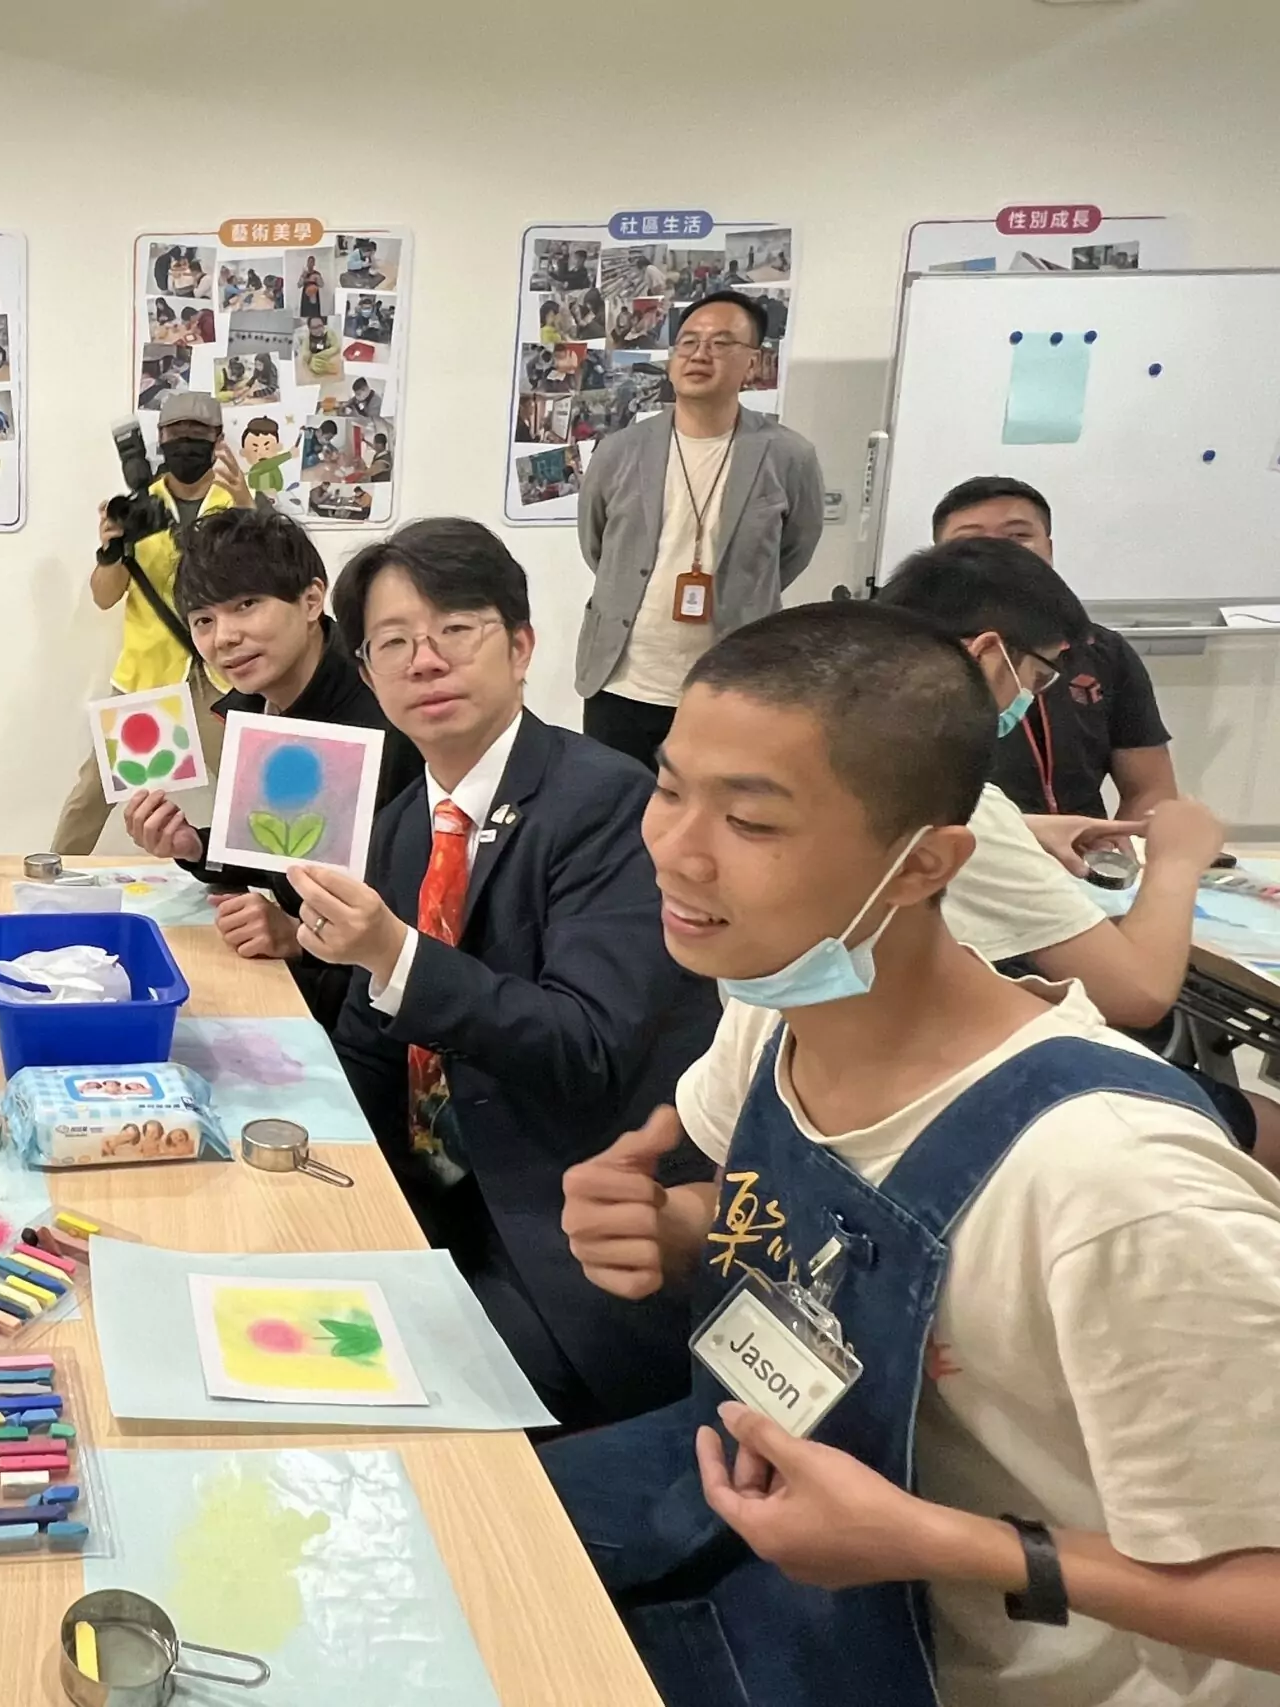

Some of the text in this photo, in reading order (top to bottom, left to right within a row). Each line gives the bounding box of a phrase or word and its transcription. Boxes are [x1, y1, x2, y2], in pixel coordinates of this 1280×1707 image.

[620, 215, 702, 234] 社區生活
[1008, 209, 1090, 229] 性別成長
[231, 222, 312, 242] 藝術美學
[730, 1332, 800, 1409] Jason
